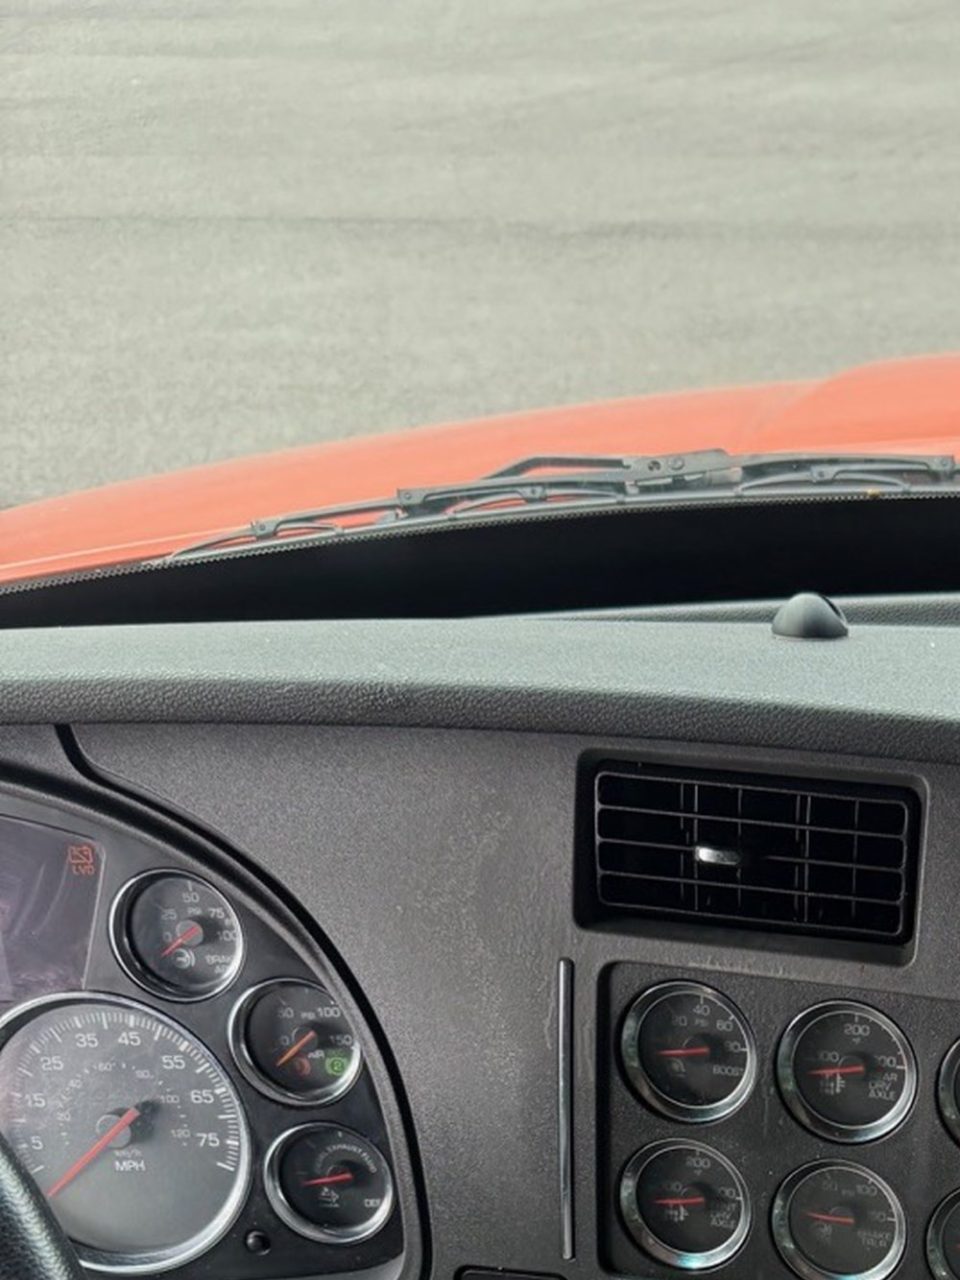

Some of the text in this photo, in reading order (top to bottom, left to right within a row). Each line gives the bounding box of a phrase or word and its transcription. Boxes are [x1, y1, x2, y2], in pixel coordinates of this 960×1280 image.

[182, 892, 199, 903] 50
[161, 908, 177, 921] 25
[208, 908, 225, 918] 75
[317, 1006, 341, 1018] 100
[693, 1004, 711, 1016] 40
[716, 1019, 734, 1031] 60
[843, 1024, 871, 1036] 200
[75, 1032, 98, 1048] 35
[117, 1031, 142, 1047] 45
[40, 1056, 64, 1070] 25
[161, 1055, 186, 1070] 55
[25, 1092, 46, 1108] 15
[190, 1089, 214, 1104] 65
[31, 1136, 43, 1150] 5
[197, 1132, 220, 1147] 75
[115, 1160, 146, 1171] MPH
